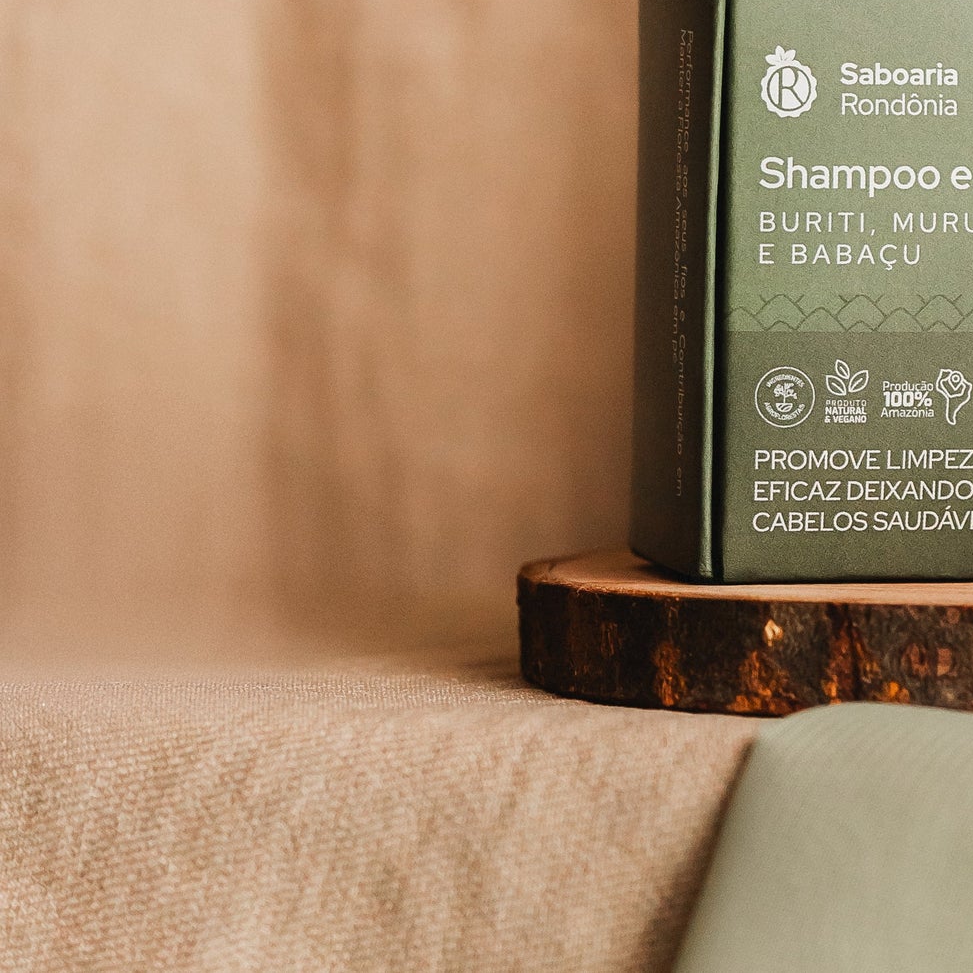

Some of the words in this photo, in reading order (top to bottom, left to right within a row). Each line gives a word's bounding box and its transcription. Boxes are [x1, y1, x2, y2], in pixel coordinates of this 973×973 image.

[840, 62, 958, 86] Saboaria
[684, 29, 694, 153] Performance
[841, 92, 958, 116] Rondônia
[759, 156, 941, 198] Shampoo
[759, 211, 876, 236] BURITI,
[759, 244, 774, 264] E
[791, 244, 921, 270] BABAÇU
[882, 380, 934, 393] Produção
[825, 399, 867, 407] PRODUTO
[883, 391, 933, 407] 100%
[824, 406, 867, 415] NATURAL
[824, 415, 831, 423] &
[833, 415, 867, 423] VEGANO
[881, 406, 935, 418] Amazônia
[754, 450, 881, 470] PROMOVE
[753, 481, 841, 502] EFICAZ
[847, 480, 973, 501] DEIXANDO
[752, 511, 868, 532] CABELOS
